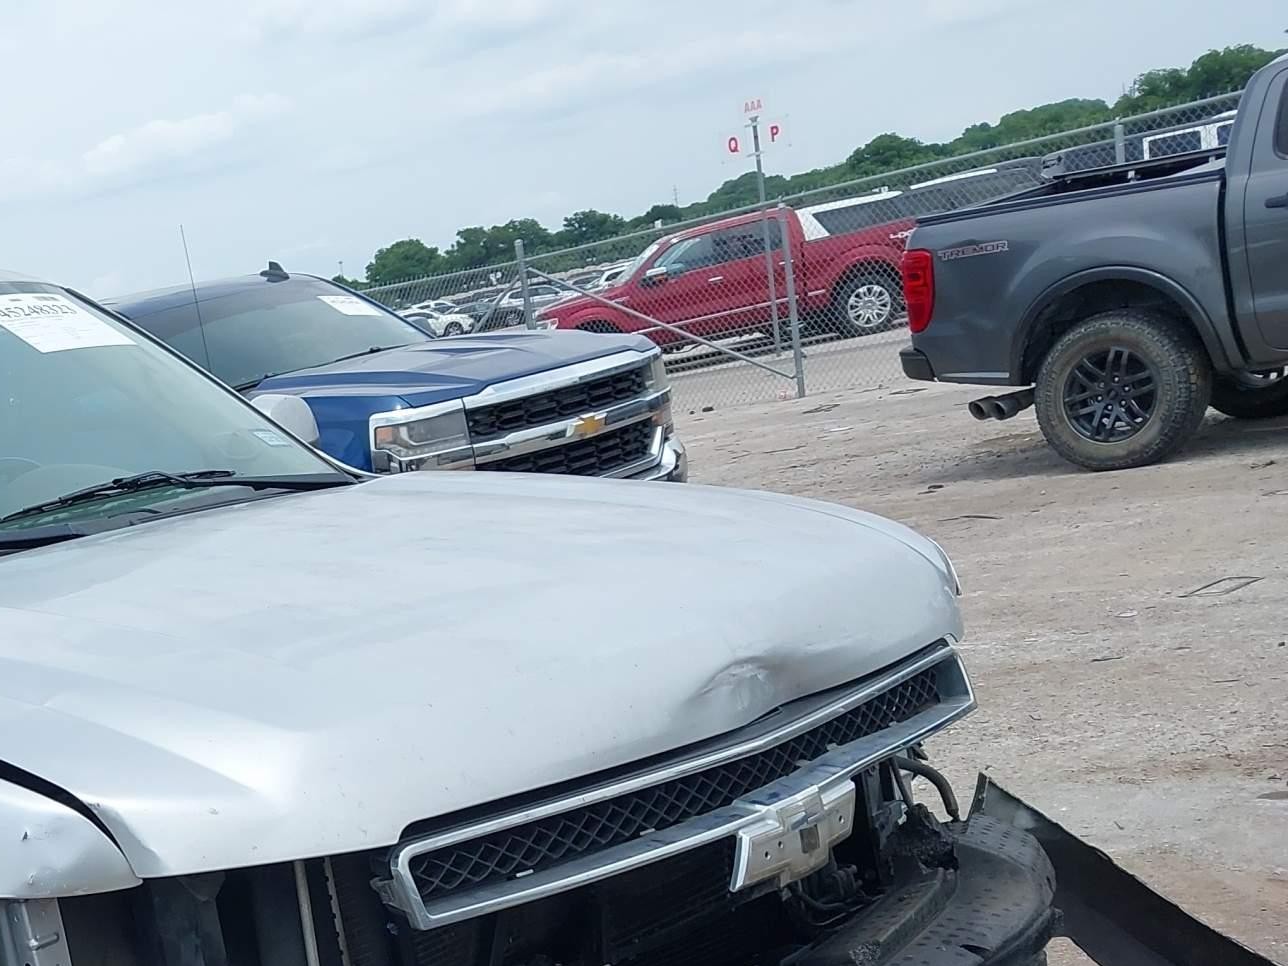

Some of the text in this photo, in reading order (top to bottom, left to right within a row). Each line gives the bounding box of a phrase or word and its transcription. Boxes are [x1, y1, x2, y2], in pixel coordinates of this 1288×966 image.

[770, 125, 780, 143] P
[728, 136, 740, 153] Q
[937, 240, 1009, 260] TREMOR
